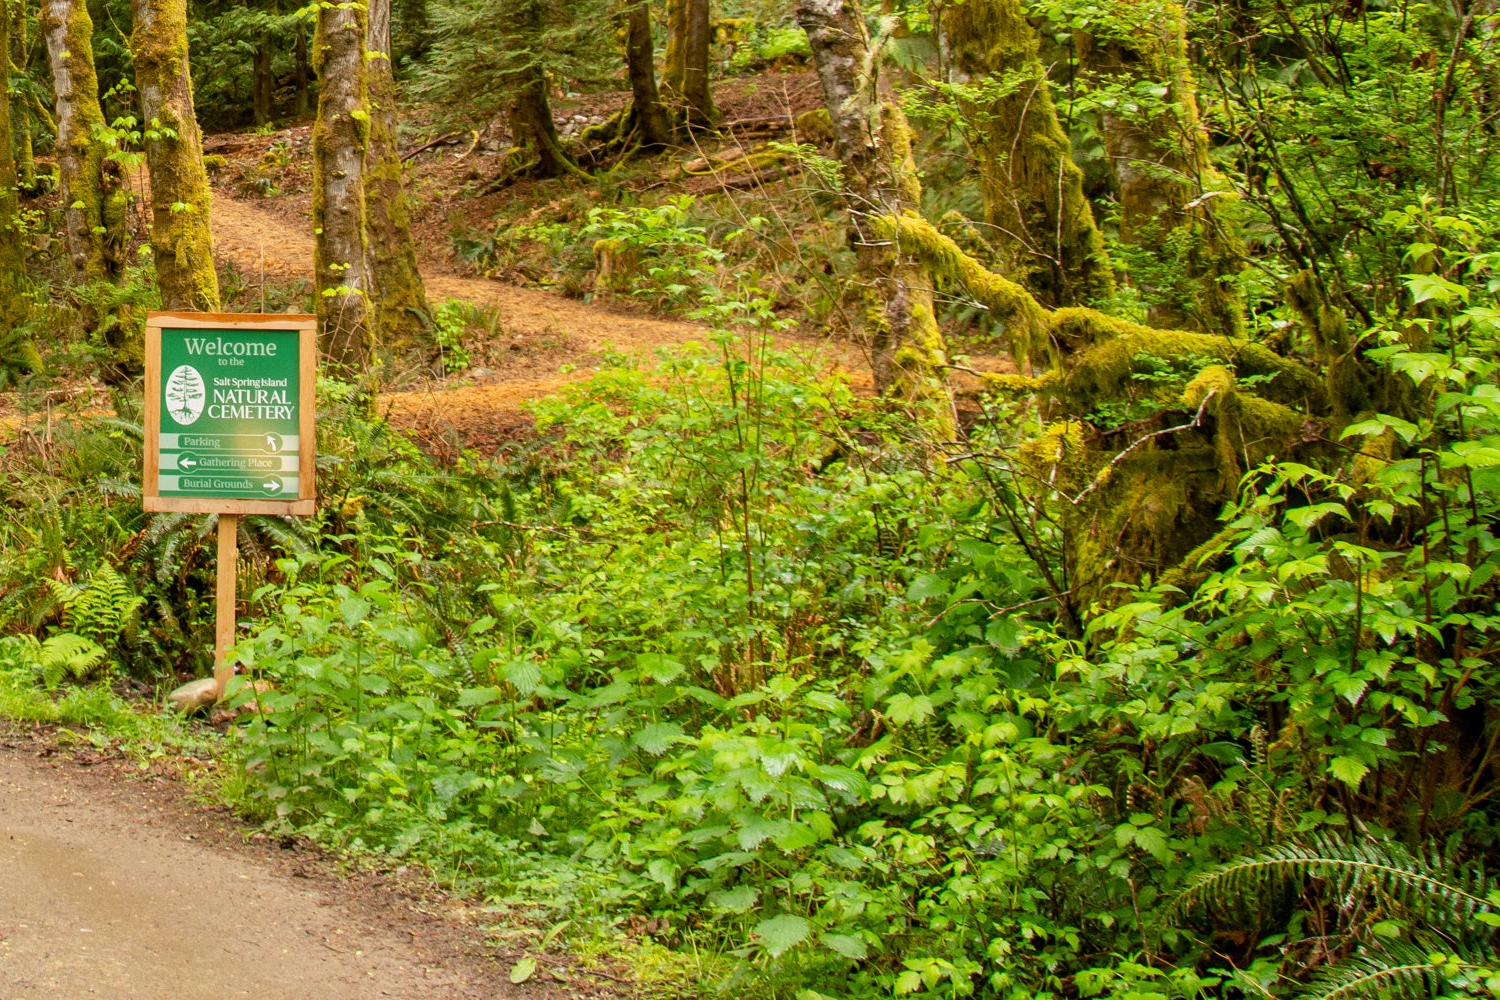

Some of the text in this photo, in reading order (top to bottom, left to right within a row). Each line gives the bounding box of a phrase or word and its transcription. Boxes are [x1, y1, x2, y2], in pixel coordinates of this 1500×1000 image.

[184, 338, 276, 356] Welcome
[230, 357, 244, 365] the
[214, 378, 287, 388] Salt Spring Island
[214, 390, 291, 404] NATURAL
[208, 405, 294, 419] CEMETERY
[184, 437, 220, 448] Parking
[200, 458, 272, 469] Gathering Place
[184, 480, 253, 489] Burial Grounds
